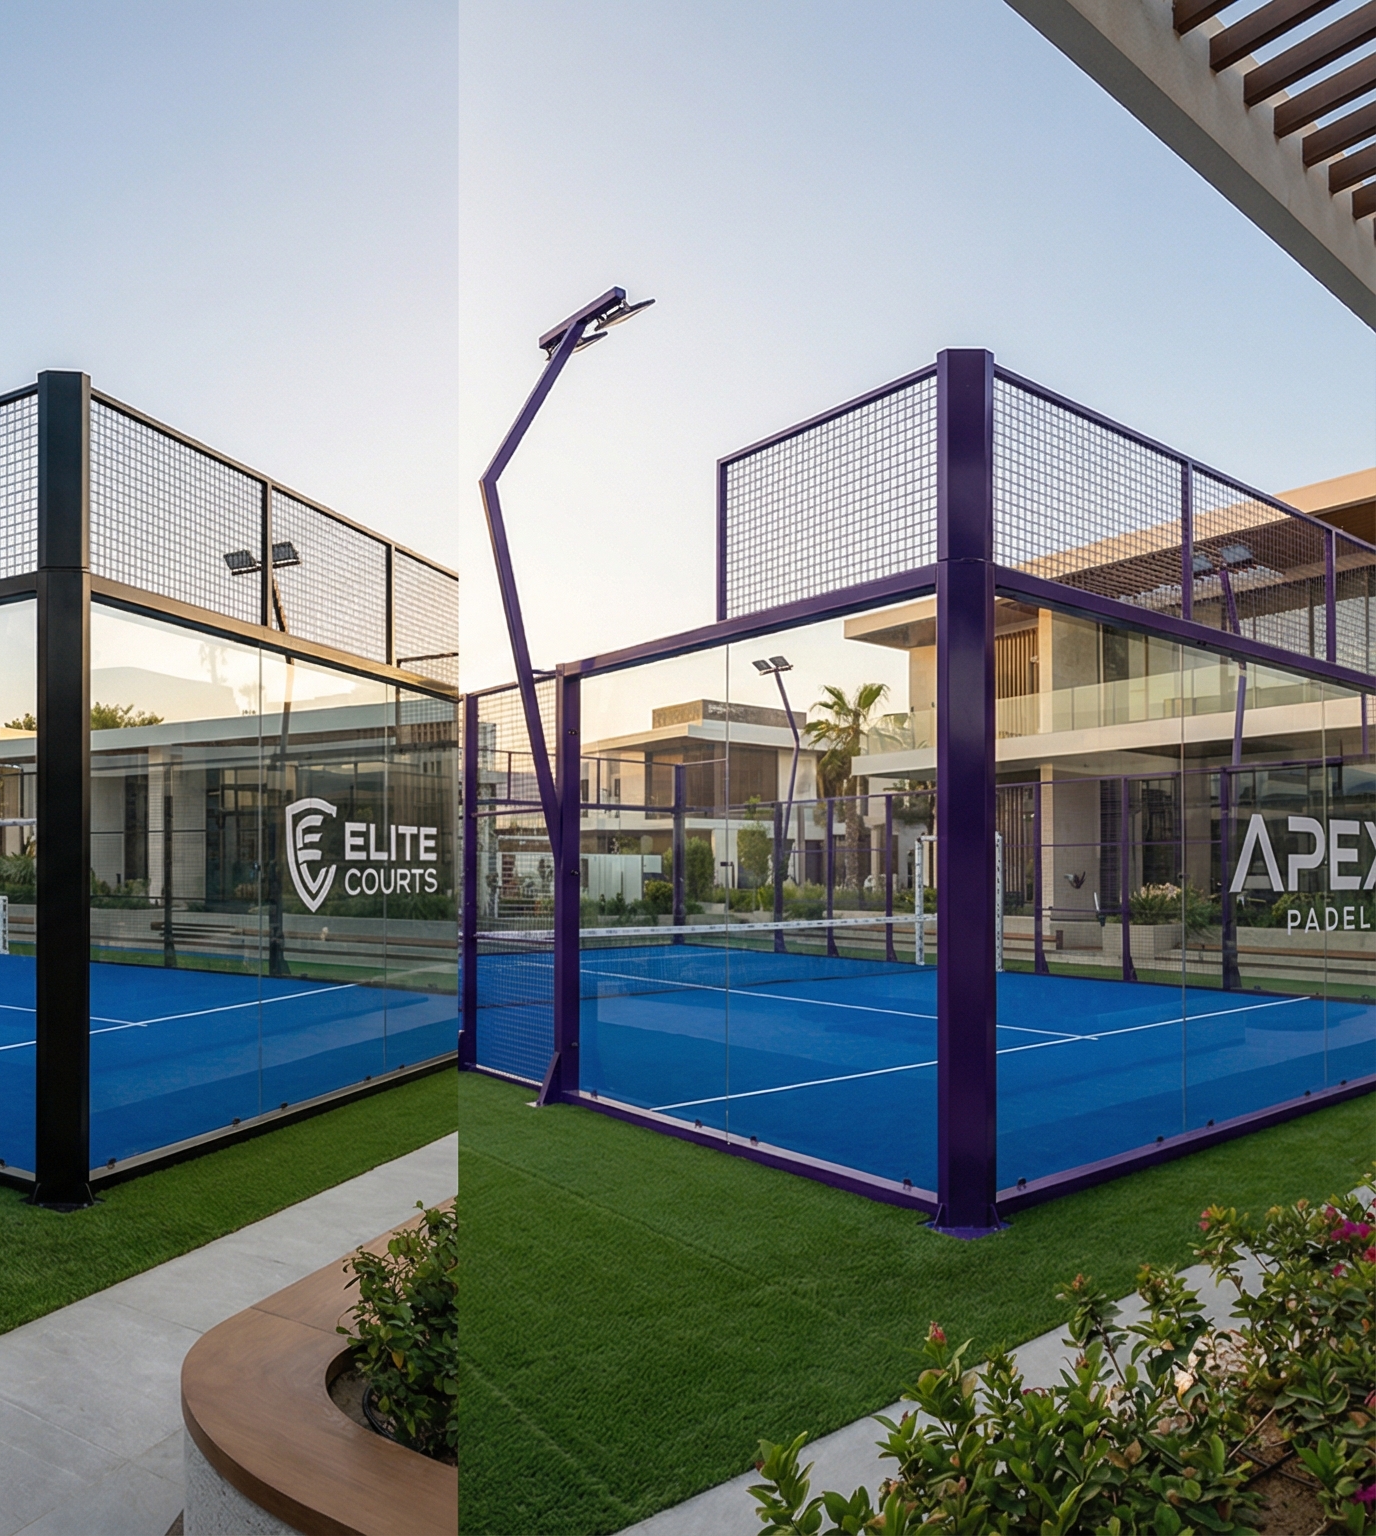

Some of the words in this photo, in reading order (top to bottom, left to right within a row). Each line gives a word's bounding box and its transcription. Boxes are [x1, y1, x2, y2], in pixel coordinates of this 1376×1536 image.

[344, 822, 438, 861] ELITE
[344, 868, 438, 896] COURTS
[1287, 906, 1371, 936] PADEL
